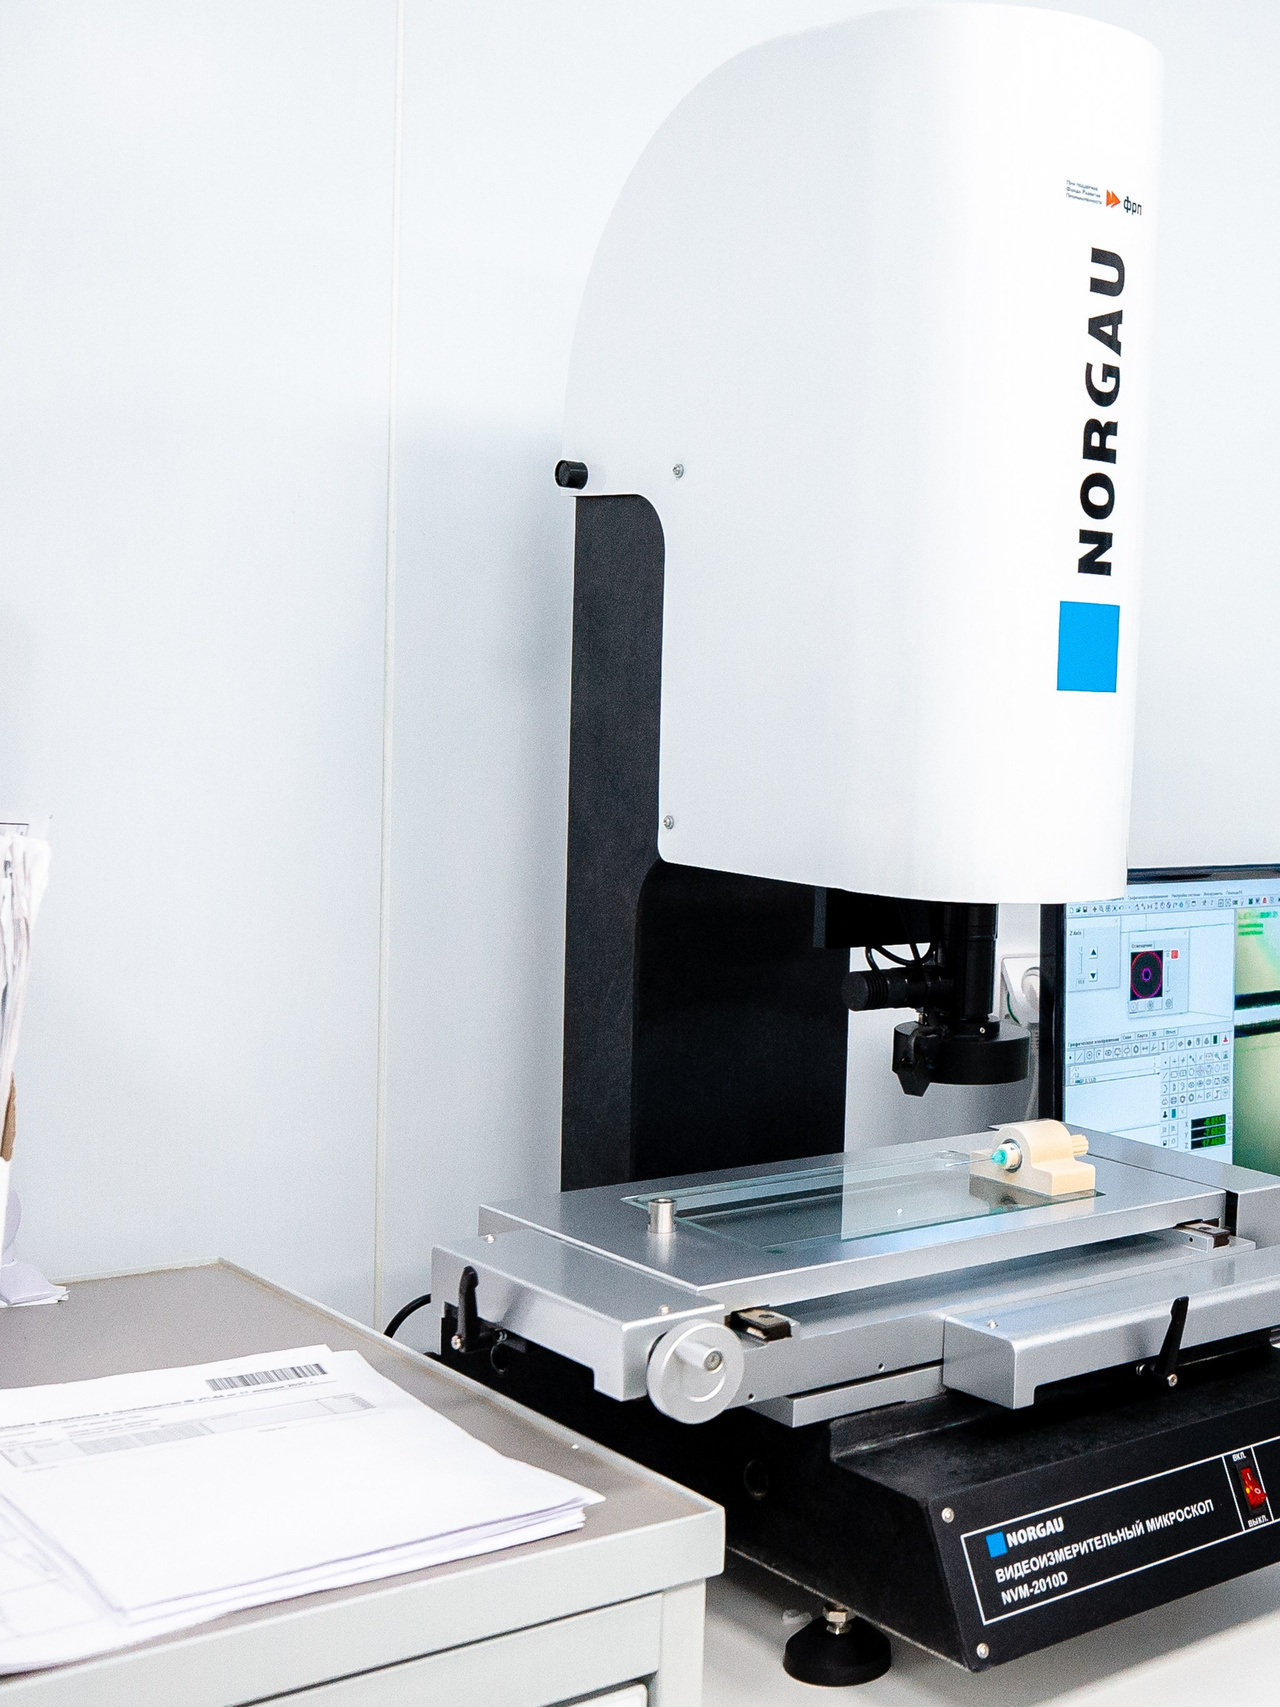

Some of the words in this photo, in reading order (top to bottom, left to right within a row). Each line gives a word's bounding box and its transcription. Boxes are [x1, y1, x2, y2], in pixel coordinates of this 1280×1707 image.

[1123, 196, 1142, 216] фрп
[1077, 246, 1126, 577] NORGAU
[994, 1518, 1146, 1584] ВИДЕОИЗМЕРИТЕЛЬНЫЙ
[1146, 1498, 1215, 1535] МИКРОСКОП
[1005, 1516, 1065, 1549] NORGAU
[1000, 1570, 1069, 1606] NVM-2010D
